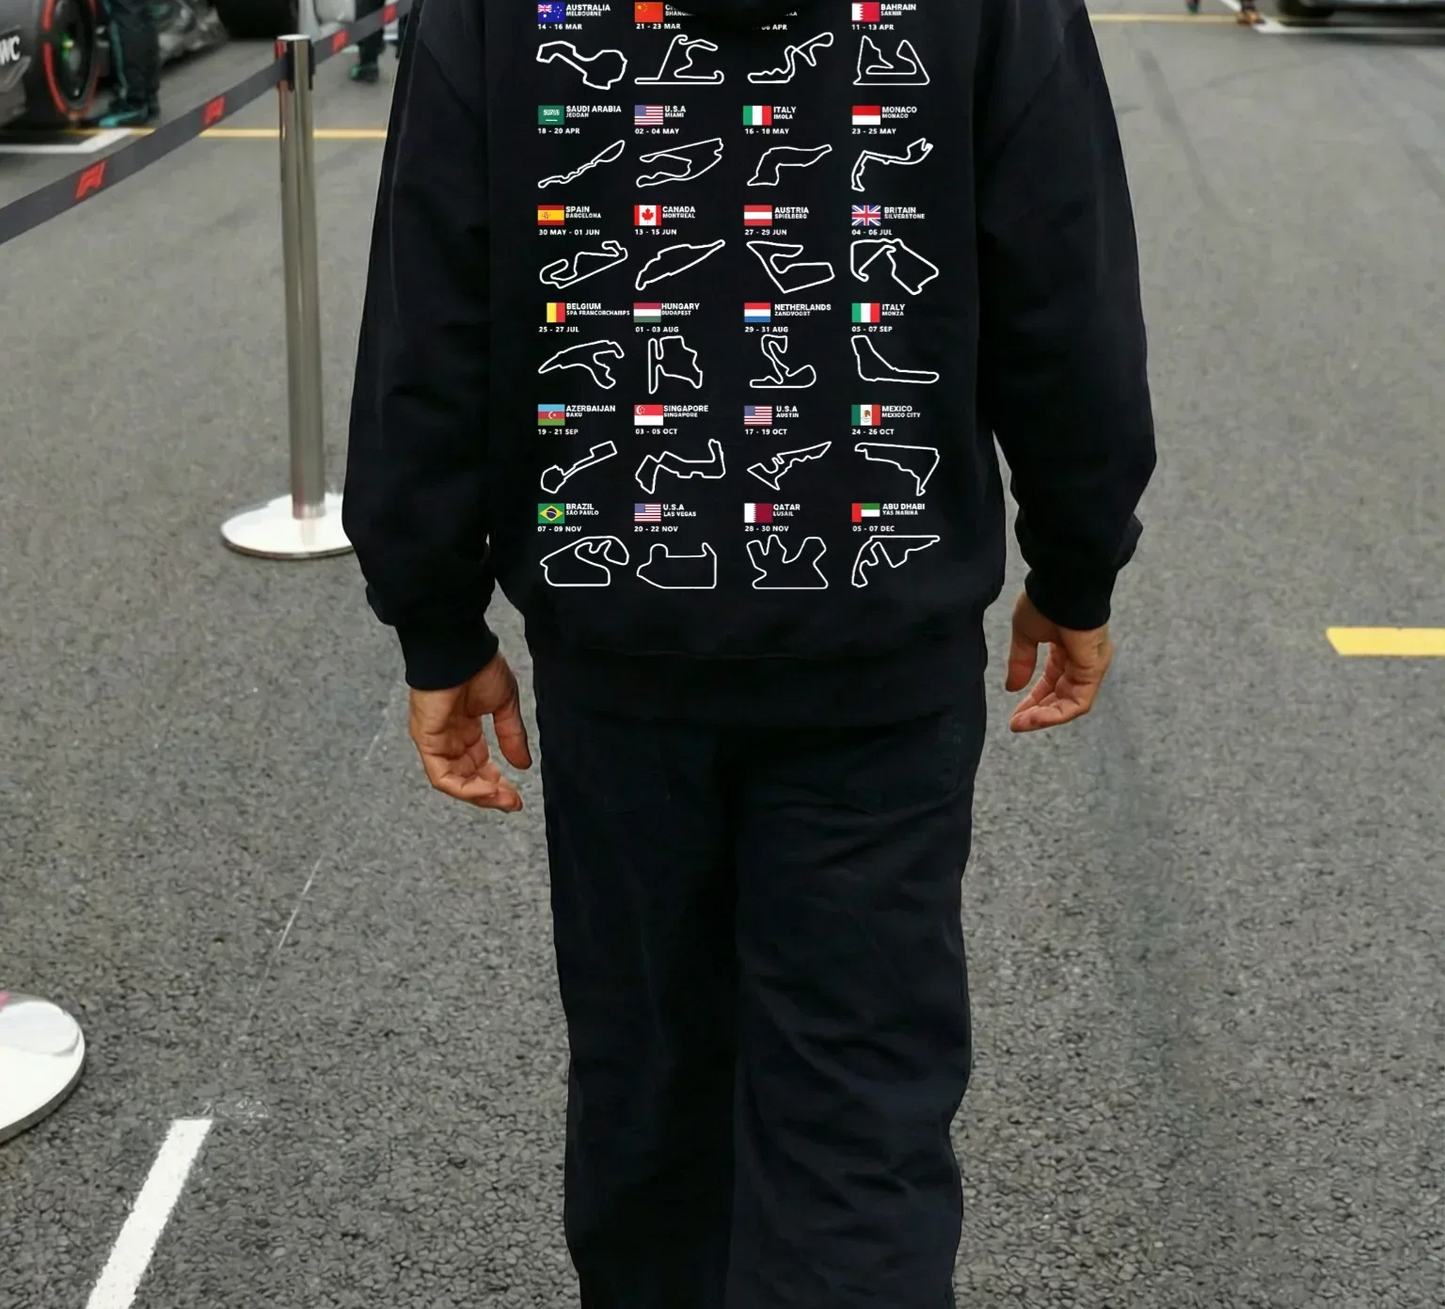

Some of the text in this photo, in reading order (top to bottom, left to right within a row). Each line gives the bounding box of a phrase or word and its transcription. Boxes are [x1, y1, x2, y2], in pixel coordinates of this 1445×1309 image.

[566, 3, 611, 11] AUSTRALIA
[881, 3, 917, 11] BAHRAIN
[772, 23, 788, 31] APR
[852, 23, 860, 31] 11
[869, 23, 878, 31] 13
[879, 23, 895, 31] APR
[566, 105, 591, 113] SAUDI
[592, 105, 622, 113] ARABIA
[665, 105, 687, 113] U.S.A
[774, 106, 797, 114] ITALY
[882, 106, 918, 114] MONACO
[538, 127, 547, 135] 18
[554, 127, 564, 135] 20
[565, 127, 581, 135] APR
[635, 127, 645, 135] 02
[651, 127, 661, 135] 04
[663, 127, 680, 135] MAY
[745, 127, 755, 135] 16
[762, 127, 771, 135] 18
[773, 127, 790, 135] MAY
[852, 127, 862, 135] 23
[869, 127, 878, 135] 25
[880, 127, 897, 135] MAY
[566, 205, 591, 213] SPAIN
[662, 205, 696, 213] CANADA
[775, 206, 810, 214] AUSTRIA
[884, 206, 917, 214] BRITAIN
[539, 228, 549, 236] 30
[550, 228, 567, 236] MAY
[574, 228, 583, 236] 01
[585, 228, 601, 236] JUN
[635, 228, 644, 236] 13
[652, 228, 661, 236] 15
[662, 228, 678, 236] JUN
[745, 228, 755, 236] 27
[762, 228, 771, 236] 29
[773, 228, 788, 236] JUN
[852, 228, 862, 236] 04
[869, 228, 878, 236] 06
[879, 228, 893, 236] JUL
[567, 302, 602, 310] BELGIUM
[661, 302, 701, 310] HUNGARY
[775, 303, 832, 311] NETHERLANDS
[882, 303, 906, 311] ITALY
[852, 325, 862, 333] 05
[869, 325, 878, 333] 07
[880, 325, 893, 333] SEP
[566, 404, 616, 413] AZERBAIJAN
[664, 404, 709, 413] SINGAPORE
[776, 405, 798, 413] U.S.A
[882, 405, 913, 413] MEXICO
[538, 428, 547, 436] 19
[554, 428, 563, 436] 21
[565, 428, 579, 436] SEP
[745, 428, 755, 436] 17
[762, 428, 771, 436] 19
[772, 428, 788, 436] OCT
[852, 428, 862, 436] 24
[869, 428, 878, 436] 26
[879, 428, 895, 436] OCT
[566, 502, 595, 510] BRAZIL
[663, 503, 685, 511] U.S.A
[773, 503, 801, 511] QATAR
[883, 502, 926, 510] ABU DHABI
[538, 525, 547, 533] 07
[554, 525, 564, 533] 09
[565, 525, 582, 533] NOV
[634, 525, 644, 533] 20
[651, 525, 660, 533] 22
[662, 525, 679, 533] NOV
